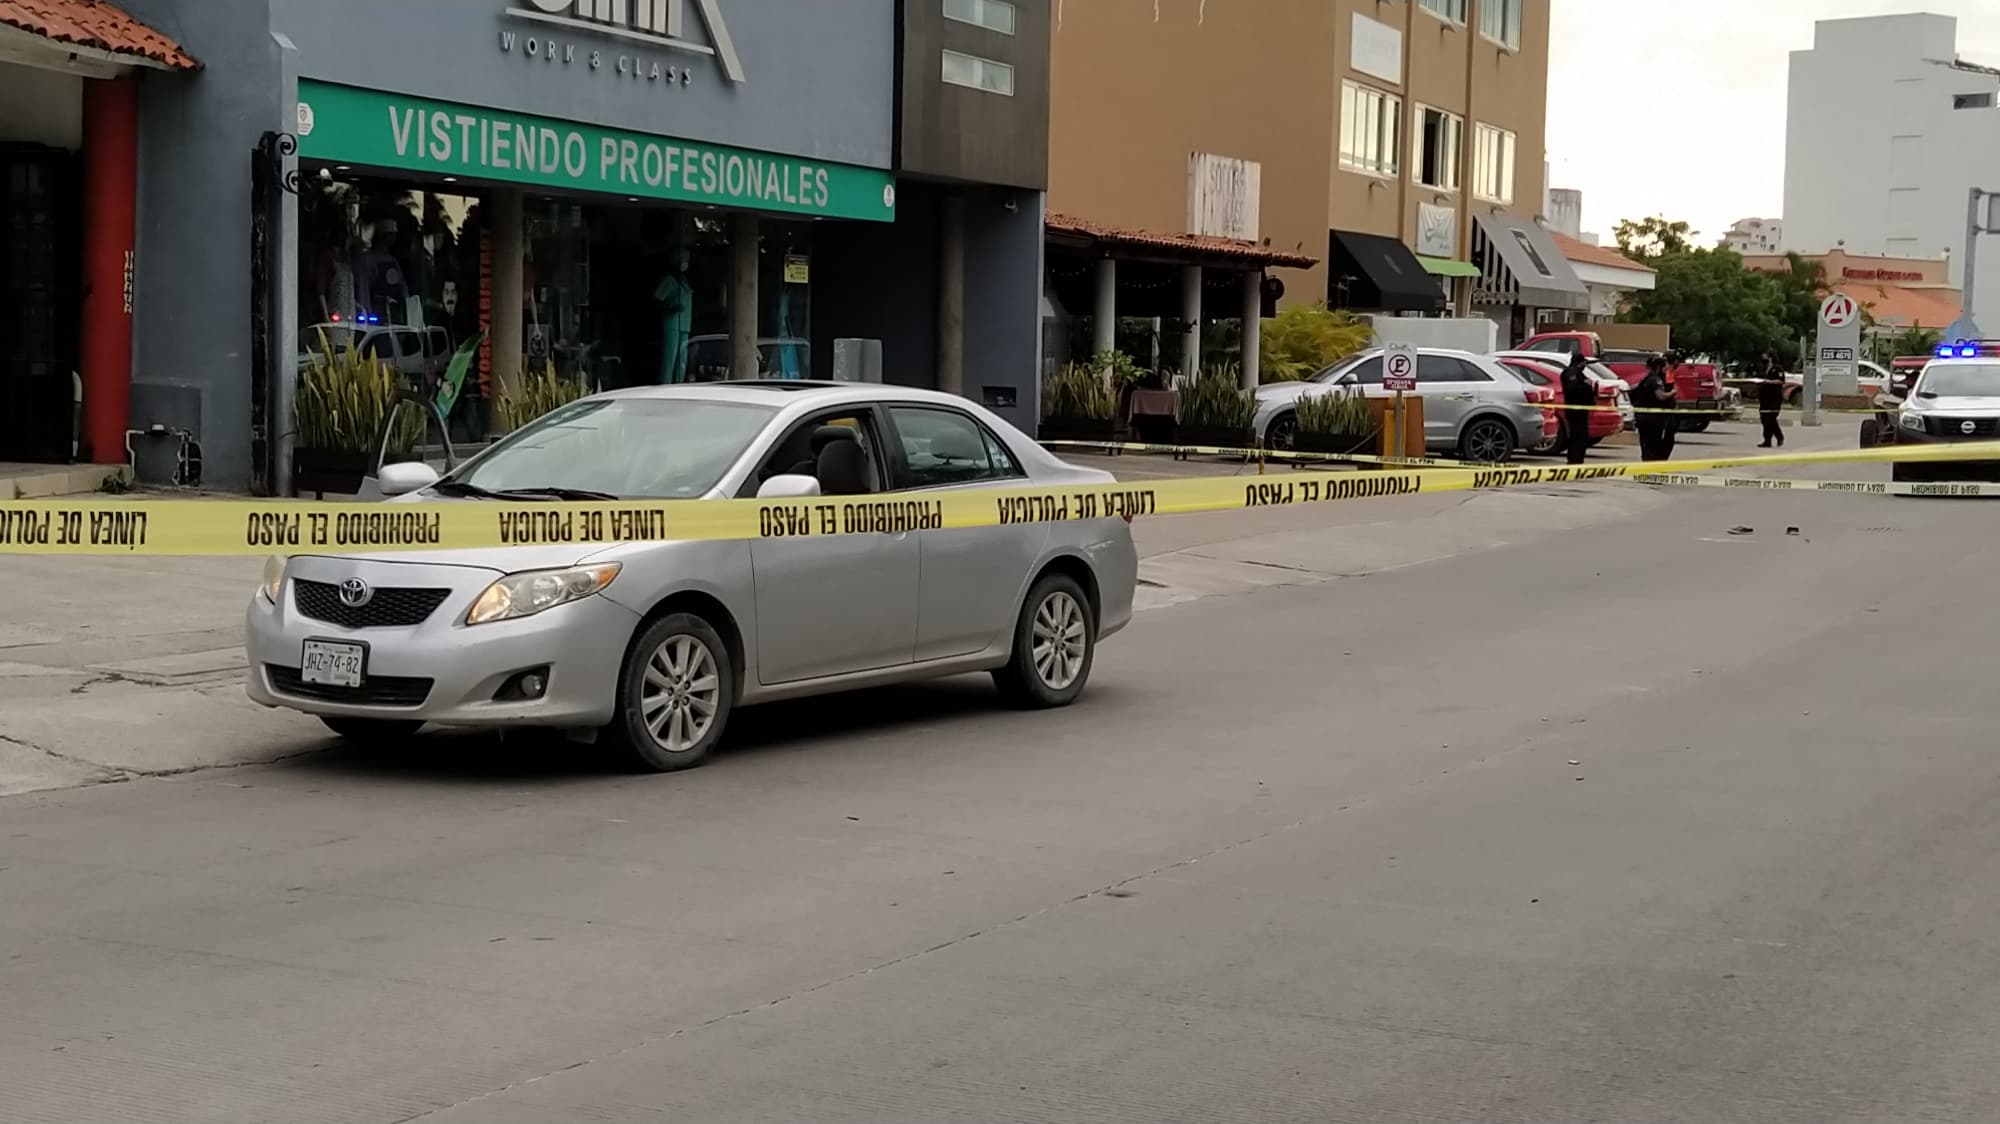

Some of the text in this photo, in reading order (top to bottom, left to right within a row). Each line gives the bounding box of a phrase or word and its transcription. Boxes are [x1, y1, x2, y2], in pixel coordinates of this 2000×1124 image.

[501, 31, 575, 64] WORK
[616, 55, 692, 86] CLASS
[388, 105, 829, 208] VISTIENDO PROFESIONALES
[1074, 494, 1097, 520] DE
[1246, 484, 1293, 507] PASO
[1300, 483, 1319, 503] EL
[57, 511, 82, 544] DE
[247, 512, 440, 545] PROHIBIDO EL PASO
[580, 511, 602, 541] DE
[760, 500, 942, 538] PROHIBIDO EL PASO
[305, 652, 359, 674] JHZ-74-82
